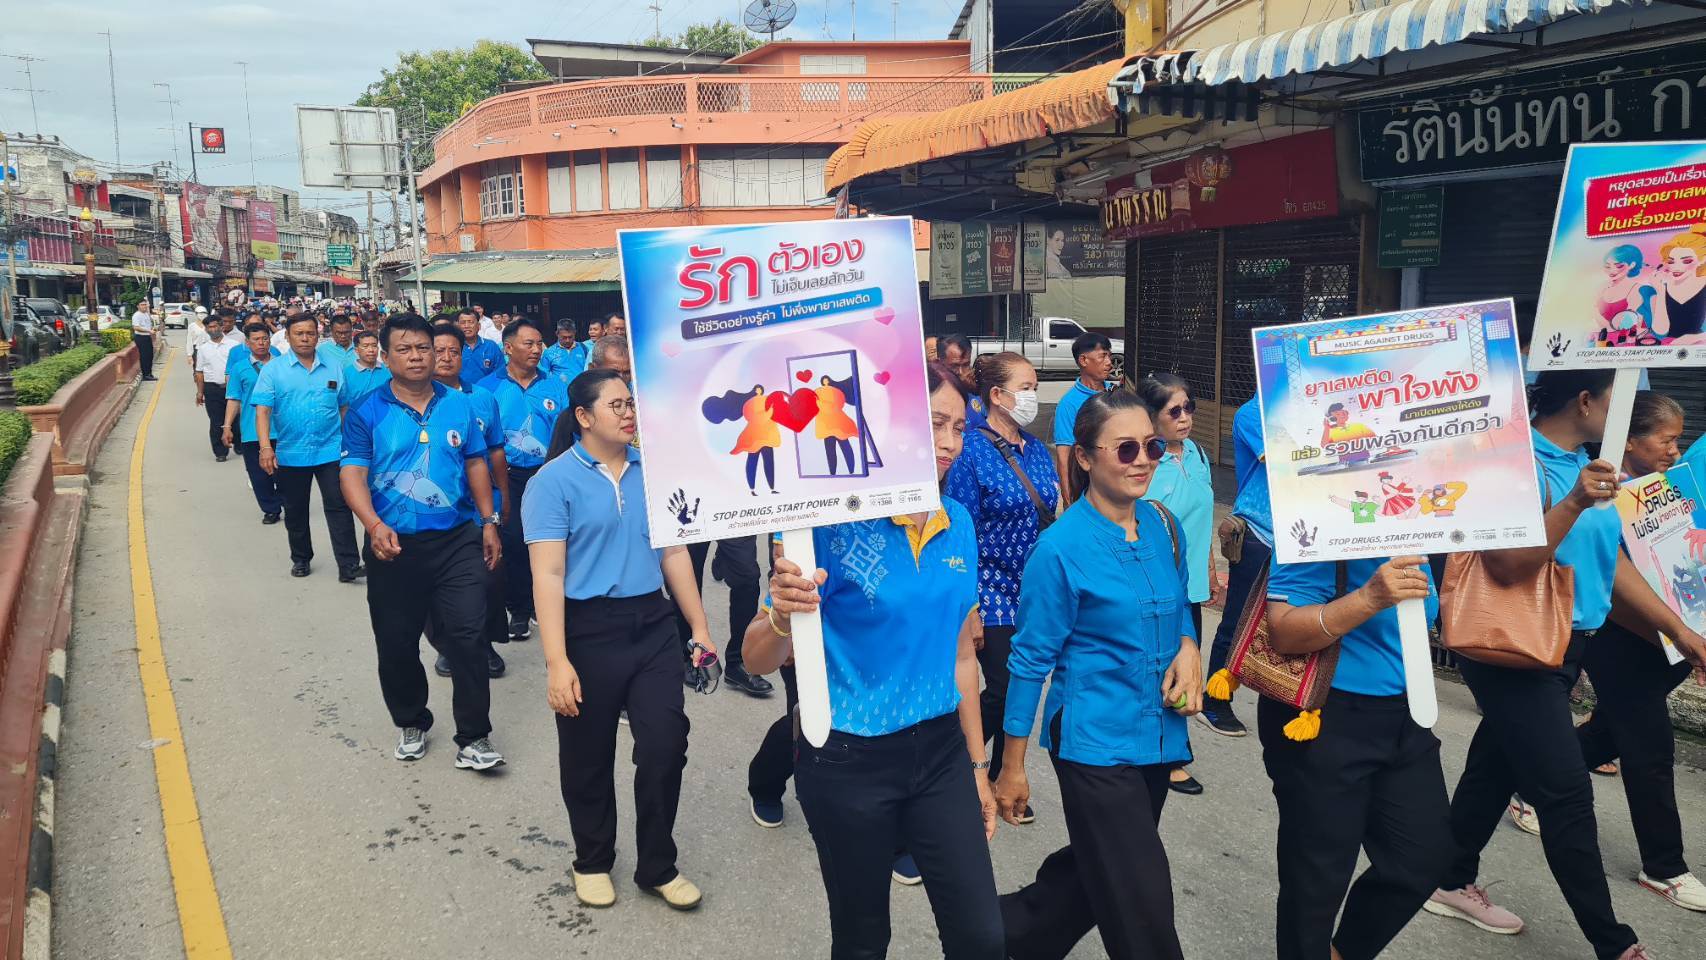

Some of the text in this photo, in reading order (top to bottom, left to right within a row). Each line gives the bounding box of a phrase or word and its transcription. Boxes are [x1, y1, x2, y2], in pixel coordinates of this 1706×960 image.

[768, 238, 864, 274] ตัวเอง
[679, 243, 760, 309] รัก
[771, 269, 864, 296] ไม่เจ็บเลยสักวัน
[693, 294, 871, 335] ใช้ชีวิตอย่างรู้ค่า ไม่พึ่งพายาเสพติด
[1364, 336, 1400, 346] AGAINST
[1403, 332, 1434, 341] DRUGS
[1305, 368, 1393, 397] ยาเสพติด
[1358, 370, 1480, 412] พาใจพัง
[1291, 413, 1503, 461] แล้ว รวมพลังกันดีกว่า
[712, 497, 841, 523] STOP DRUGS, START POWER
[1644, 485, 1682, 514] DRUGS
[1680, 498, 1697, 517] เลิก
[1328, 531, 1444, 546] STOP DRUGS, START POWER
